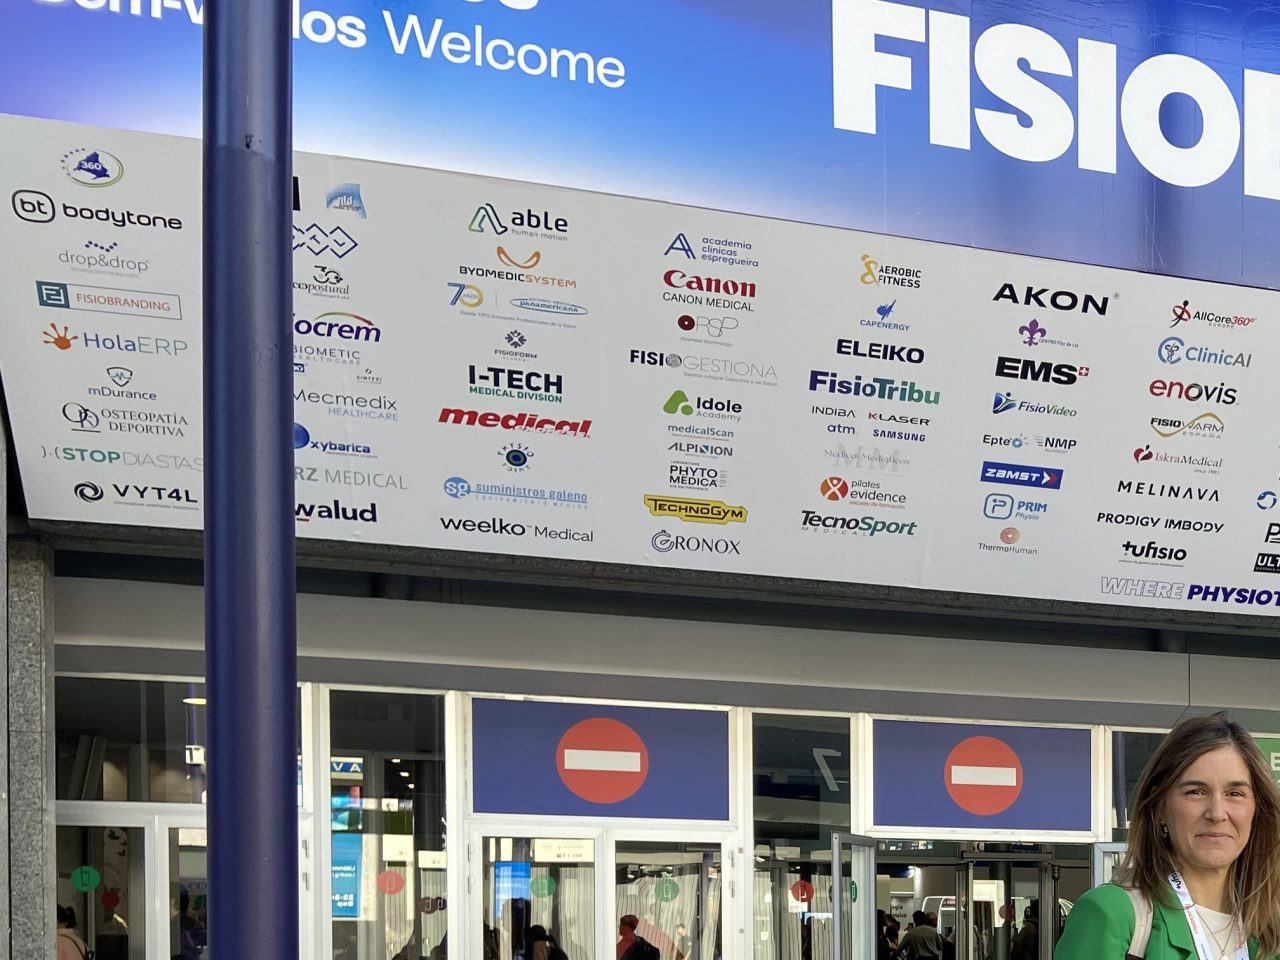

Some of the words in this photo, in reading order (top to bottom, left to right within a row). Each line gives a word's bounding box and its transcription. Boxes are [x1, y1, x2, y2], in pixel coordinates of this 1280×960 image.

[382, 10, 626, 88] Welcome
[20, 198, 48, 215] bt
[62, 203, 182, 229] bodytone
[511, 208, 568, 233] able
[511, 228, 539, 239] human
[541, 232, 568, 242] motion
[702, 237, 752, 250] academia
[59, 250, 148, 273] drop&drop
[701, 254, 759, 268] espregueira
[459, 266, 577, 289] BYOMEDICSYSTEM
[878, 265, 922, 279] AEROBIC
[293, 282, 350, 296] copostural
[663, 270, 756, 298] Canon
[878, 275, 921, 289] FITNESS
[76, 293, 171, 312] FISIOBRANDING
[520, 300, 580, 313] panamericana
[663, 292, 703, 306] CANON
[706, 298, 754, 312] MEDICAL
[992, 283, 1109, 316] AKON
[294, 319, 381, 342] ocrem
[860, 319, 910, 332] CAPENERGY
[83, 332, 188, 356] HolaERP
[836, 339, 925, 364] ELEIKO
[494, 349, 537, 360] FISIOFORM
[1185, 347, 1252, 368] ClinicAI
[629, 349, 778, 379] FISIOGESTIONA
[995, 356, 1078, 385] EMS
[469, 365, 563, 394] I-TECH
[809, 370, 940, 405] FisioTribu
[88, 387, 157, 401] mDurance
[469, 386, 515, 399] MEDICAL
[517, 391, 562, 403] DIVISION
[1150, 379, 1237, 405] enovis
[328, 407, 399, 421] HEALTHCARE
[696, 397, 742, 413] Idole
[811, 406, 856, 418] INDIBA
[1018, 401, 1077, 417] FisioVideo
[101, 408, 188, 426] OSTEOPATÍA
[696, 410, 741, 423] Academy
[109, 422, 184, 437] DEPORTIVA
[668, 425, 734, 439] medicalScan
[827, 424, 856, 435] atm
[873, 429, 926, 442] SAMSUNG
[983, 434, 1011, 446] Epte
[1045, 437, 1077, 450] NMP
[1155, 452, 1223, 468] IskraMedical
[325, 468, 408, 490] MEDICAL
[670, 465, 718, 479] PHYTO
[112, 484, 198, 503] VYT4L
[476, 483, 545, 498] suministros
[550, 490, 588, 502] galeno
[851, 480, 880, 490] pilates
[1117, 480, 1220, 502] MELINAVA
[850, 490, 907, 504] evidence
[1017, 501, 1048, 513] PRIM
[801, 510, 917, 536] TecnoSport
[1015, 512, 1039, 521] Physio
[1096, 512, 1161, 528] PRODIGY
[1164, 518, 1224, 533] IMBODY
[440, 517, 525, 536] weelko
[535, 526, 593, 542] Medical
[978, 543, 1038, 555] ThermoHuman
[1101, 576, 1185, 600] WHERE
